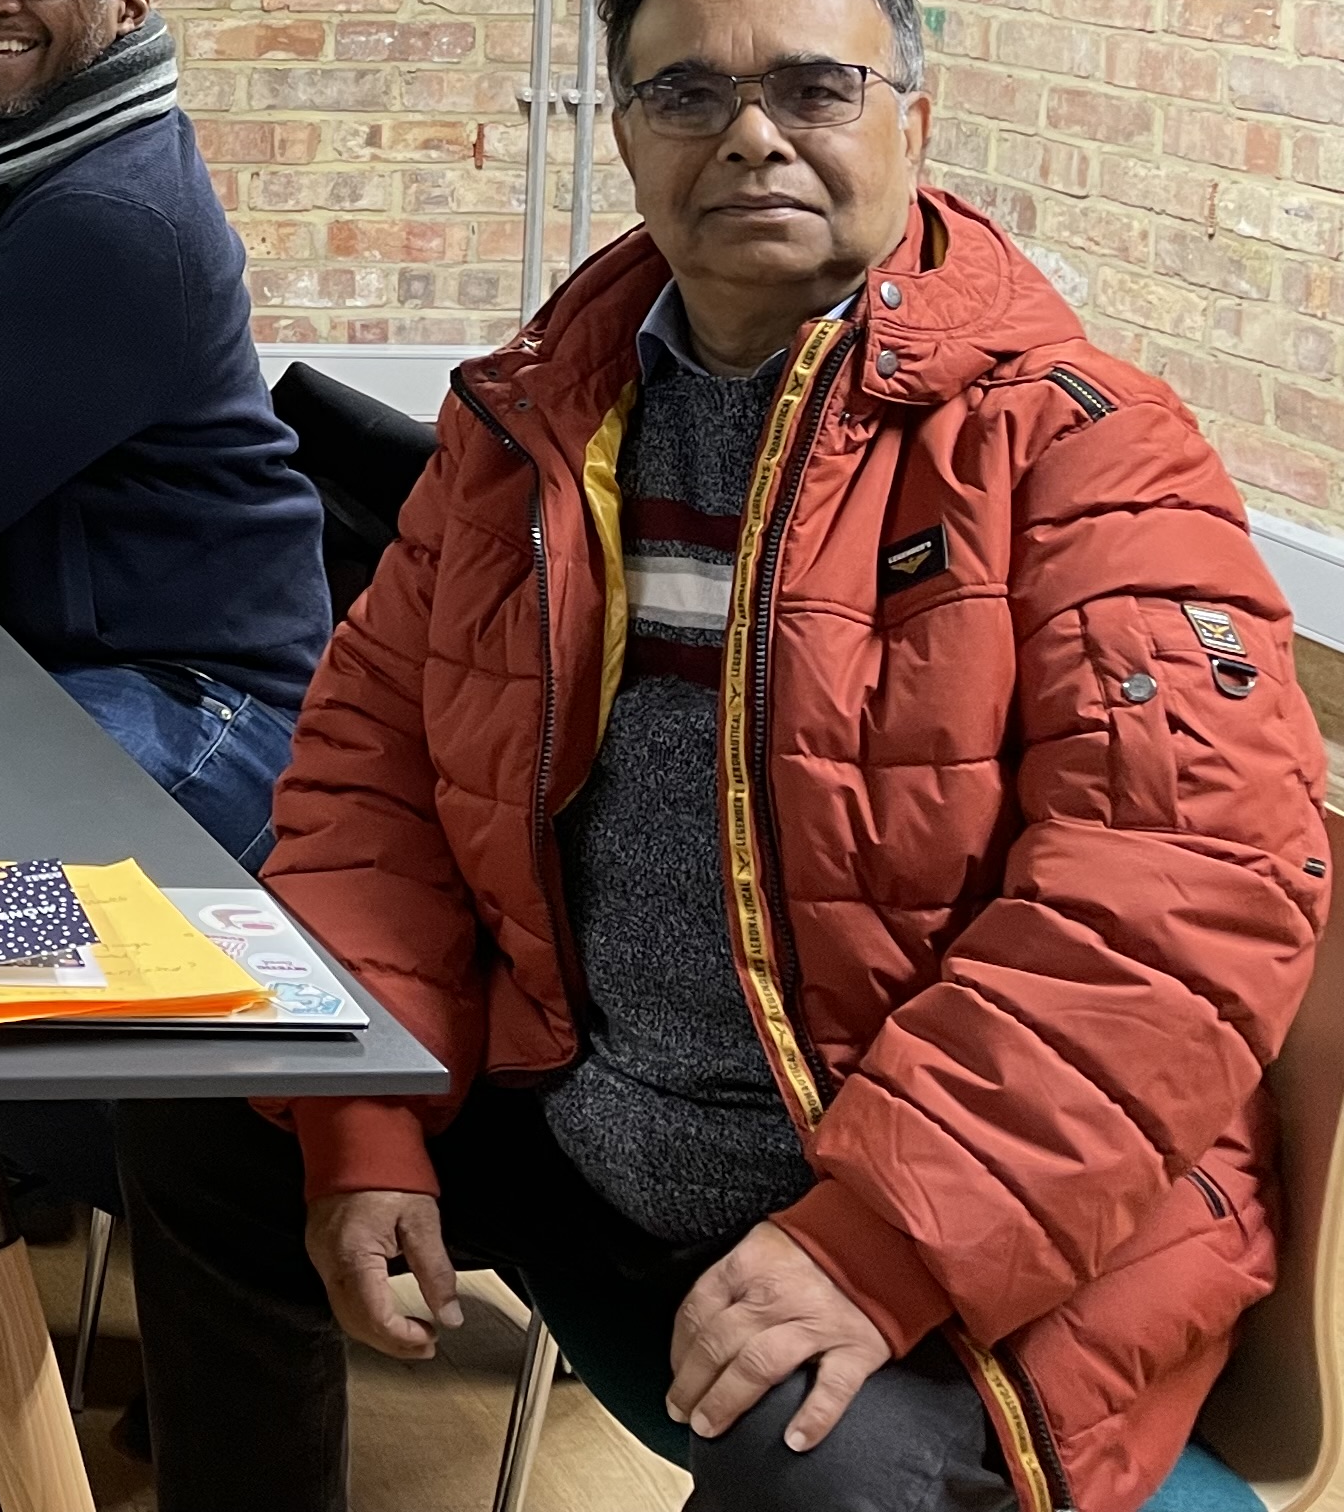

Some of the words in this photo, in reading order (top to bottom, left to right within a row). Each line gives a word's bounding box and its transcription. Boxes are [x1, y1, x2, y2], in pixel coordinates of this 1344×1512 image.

[763, 398, 795, 463] AERONAUTICAL
[729, 712, 744, 785] AERONAUTICAL
[738, 881, 762, 956] AERONAUTICAL
